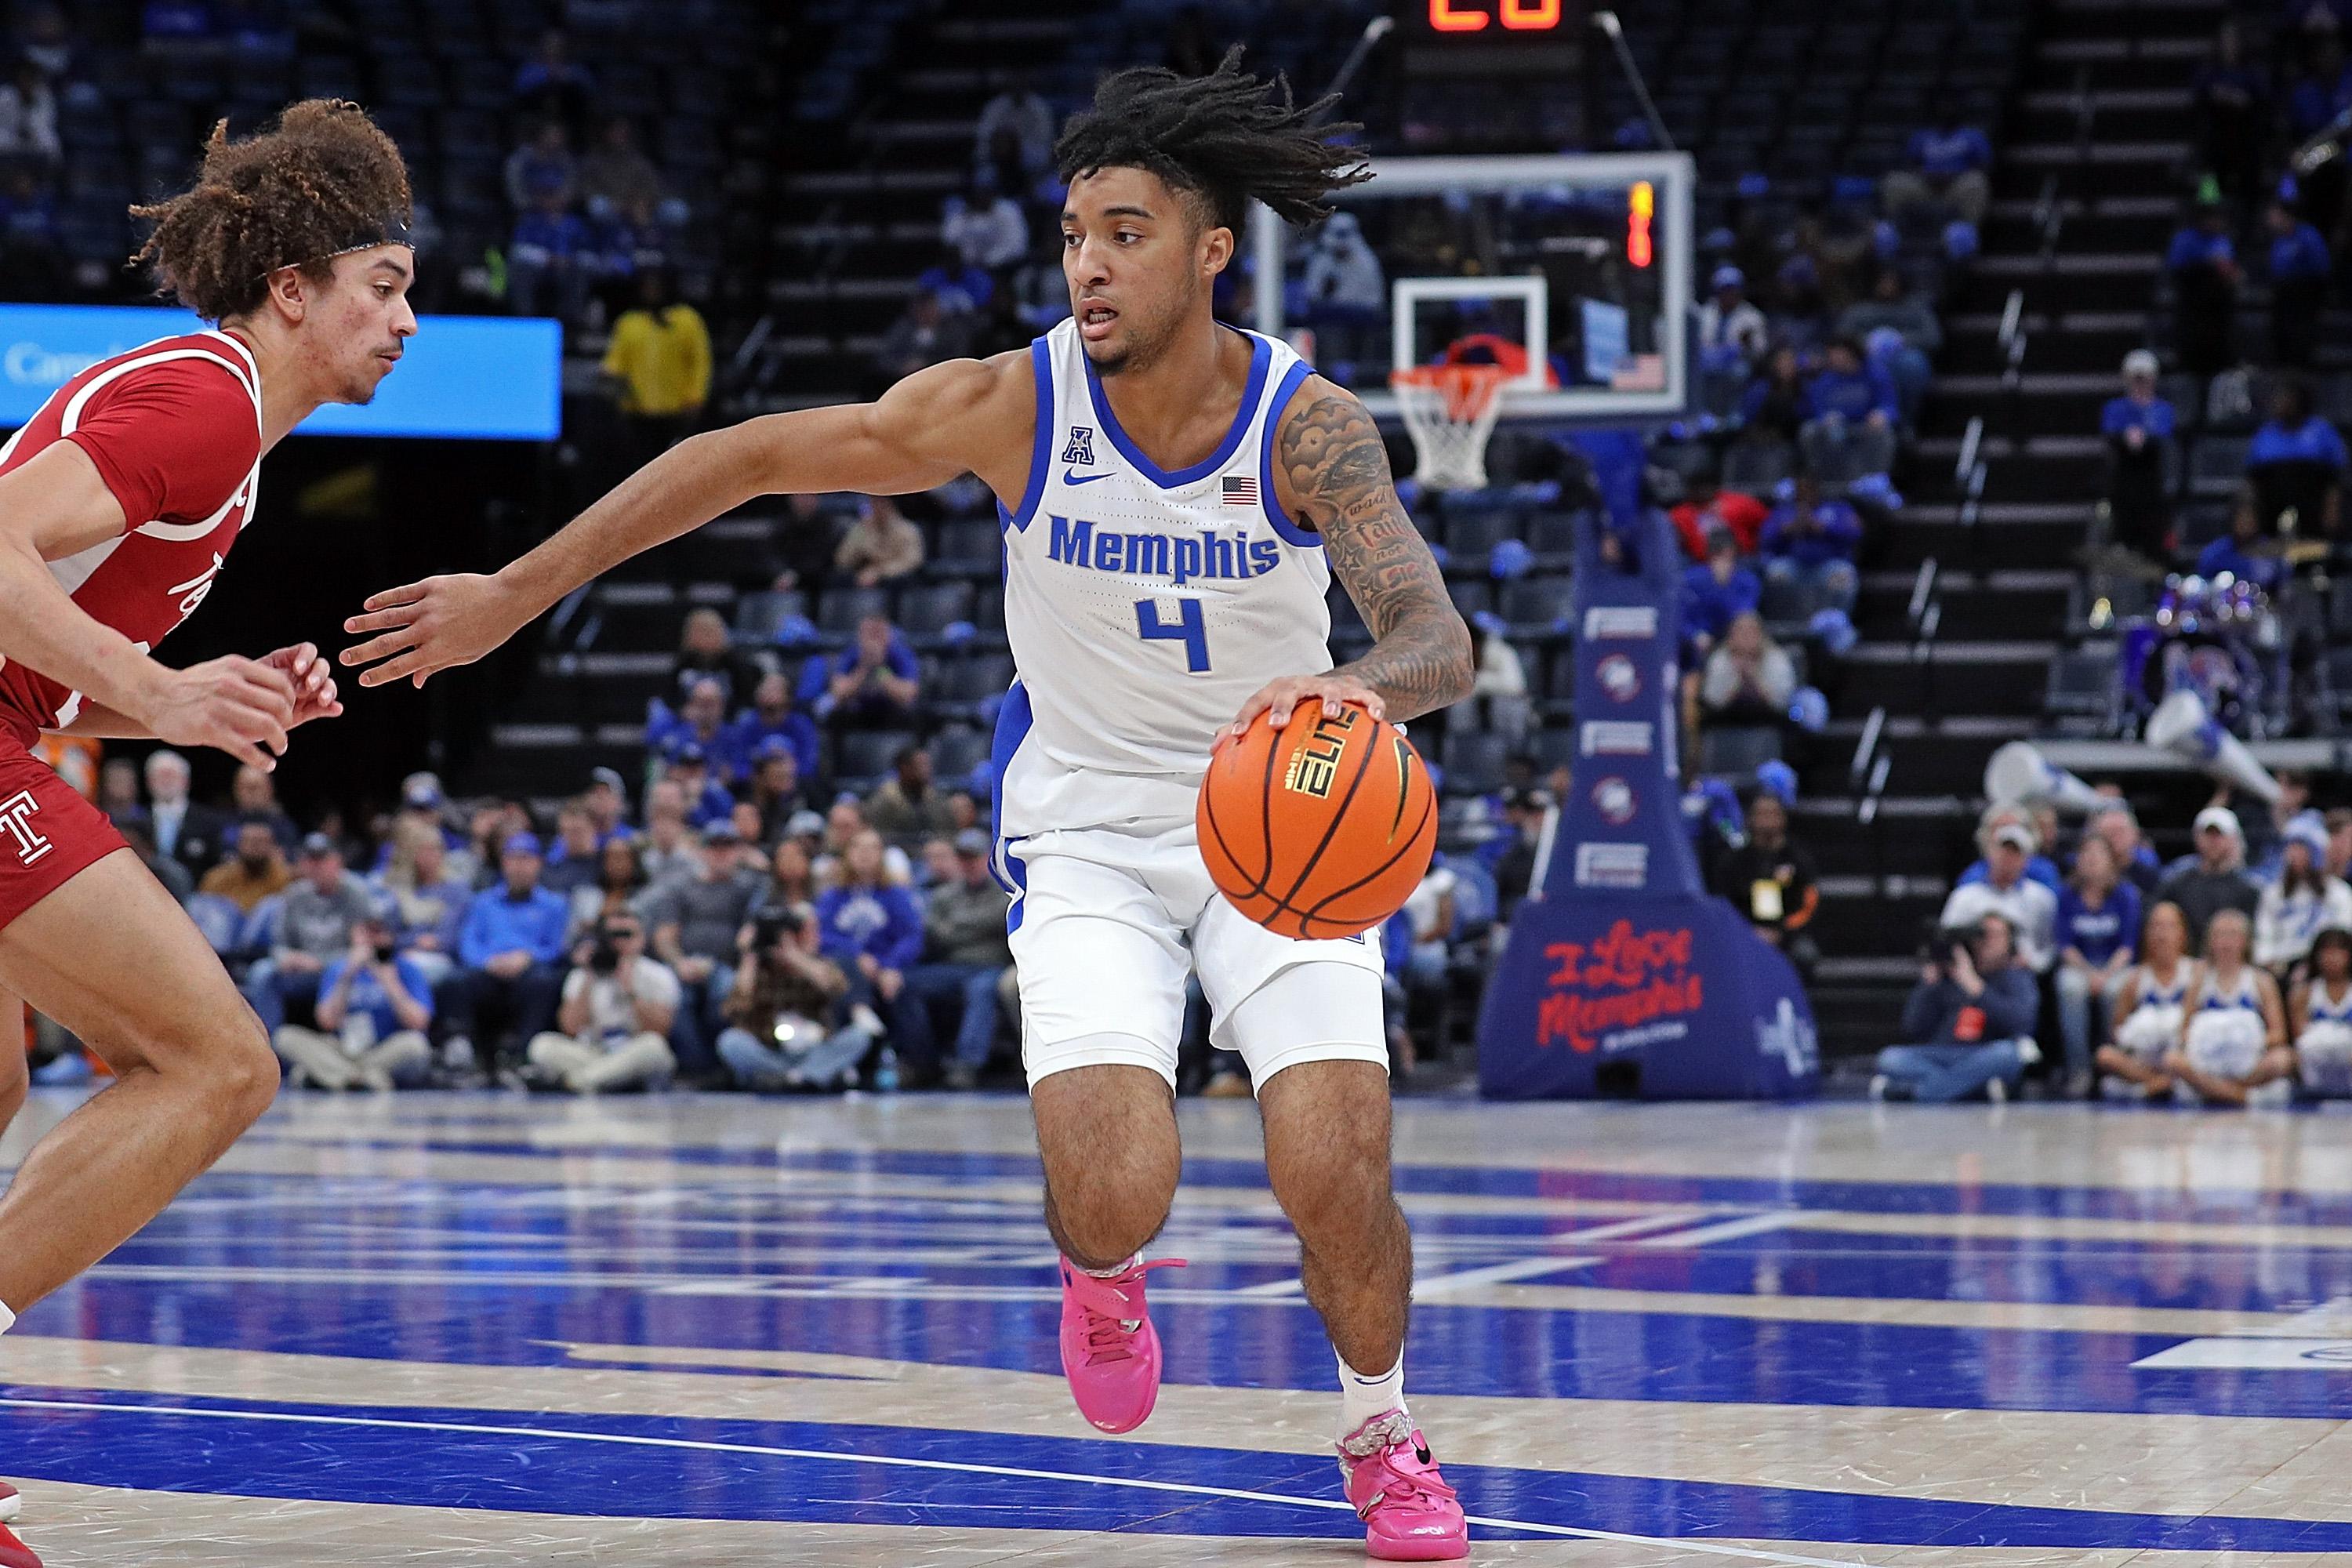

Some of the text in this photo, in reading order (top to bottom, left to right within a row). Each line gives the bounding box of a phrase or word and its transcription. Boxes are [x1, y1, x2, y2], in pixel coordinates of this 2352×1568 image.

[1062, 426, 1095, 466] A
[1045, 511, 1282, 585] Memphis
[1133, 597, 1213, 673] 4
[0, 789, 54, 866] T
